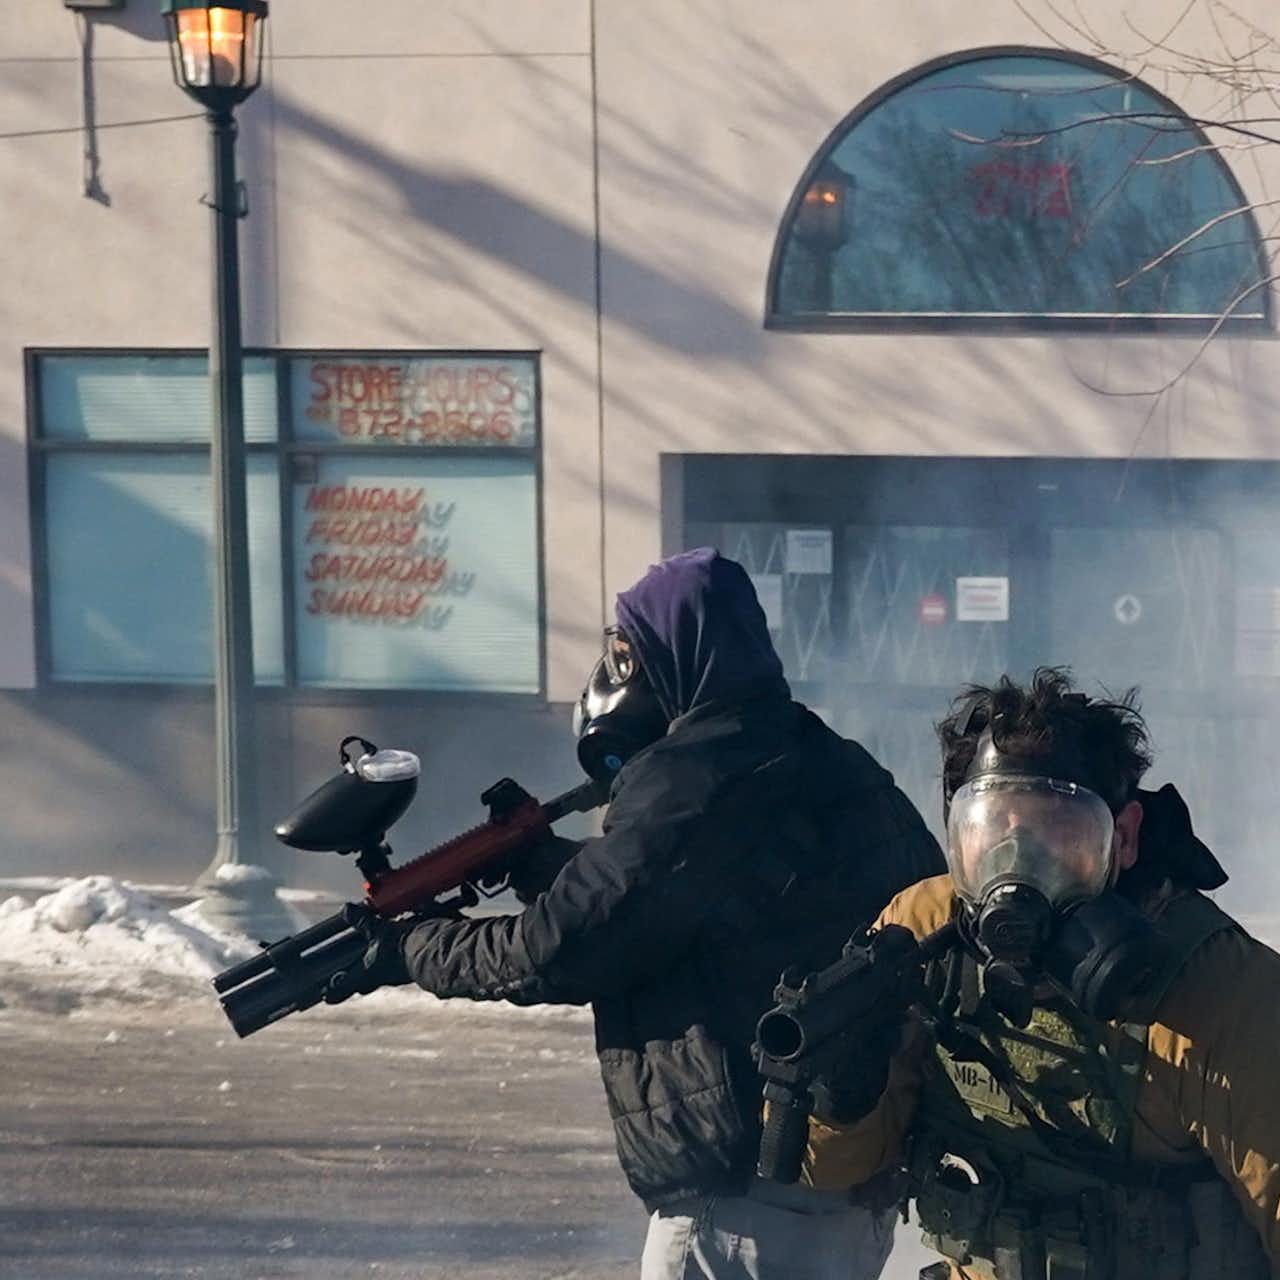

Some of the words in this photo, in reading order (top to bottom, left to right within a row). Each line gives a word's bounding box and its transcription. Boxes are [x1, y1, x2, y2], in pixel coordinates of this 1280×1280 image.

[310, 364, 402, 403] STORE
[305, 485, 424, 513] MONDAY
[306, 518, 419, 546] FRIDAY
[305, 553, 446, 583] SATURDAY
[306, 588, 424, 617] SUNDAY
